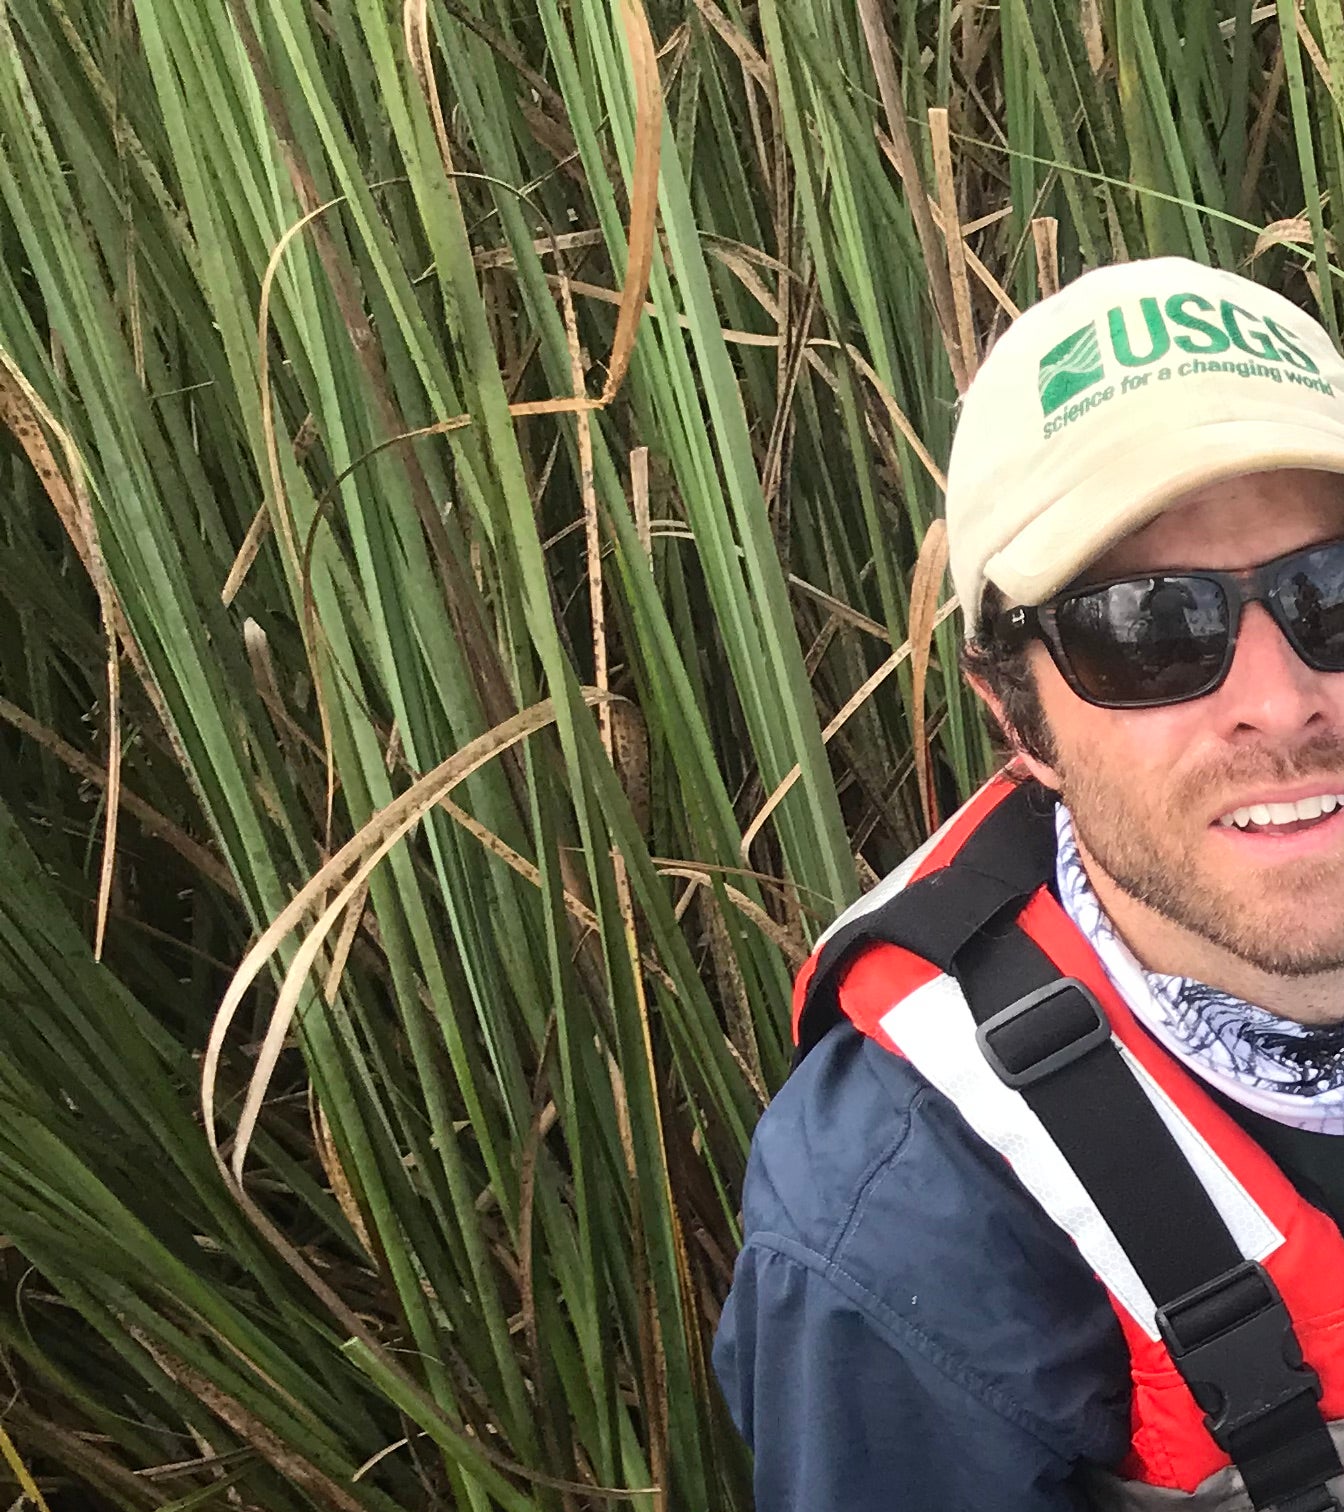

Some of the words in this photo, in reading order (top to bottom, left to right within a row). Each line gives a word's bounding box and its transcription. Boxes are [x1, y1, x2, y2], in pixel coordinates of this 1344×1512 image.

[1107, 292, 1320, 375] USGS
[1043, 385, 1115, 440] science
[1120, 370, 1153, 395] for
[1157, 365, 1172, 381] a
[1177, 358, 1282, 383] changing
[1284, 368, 1336, 399] world
